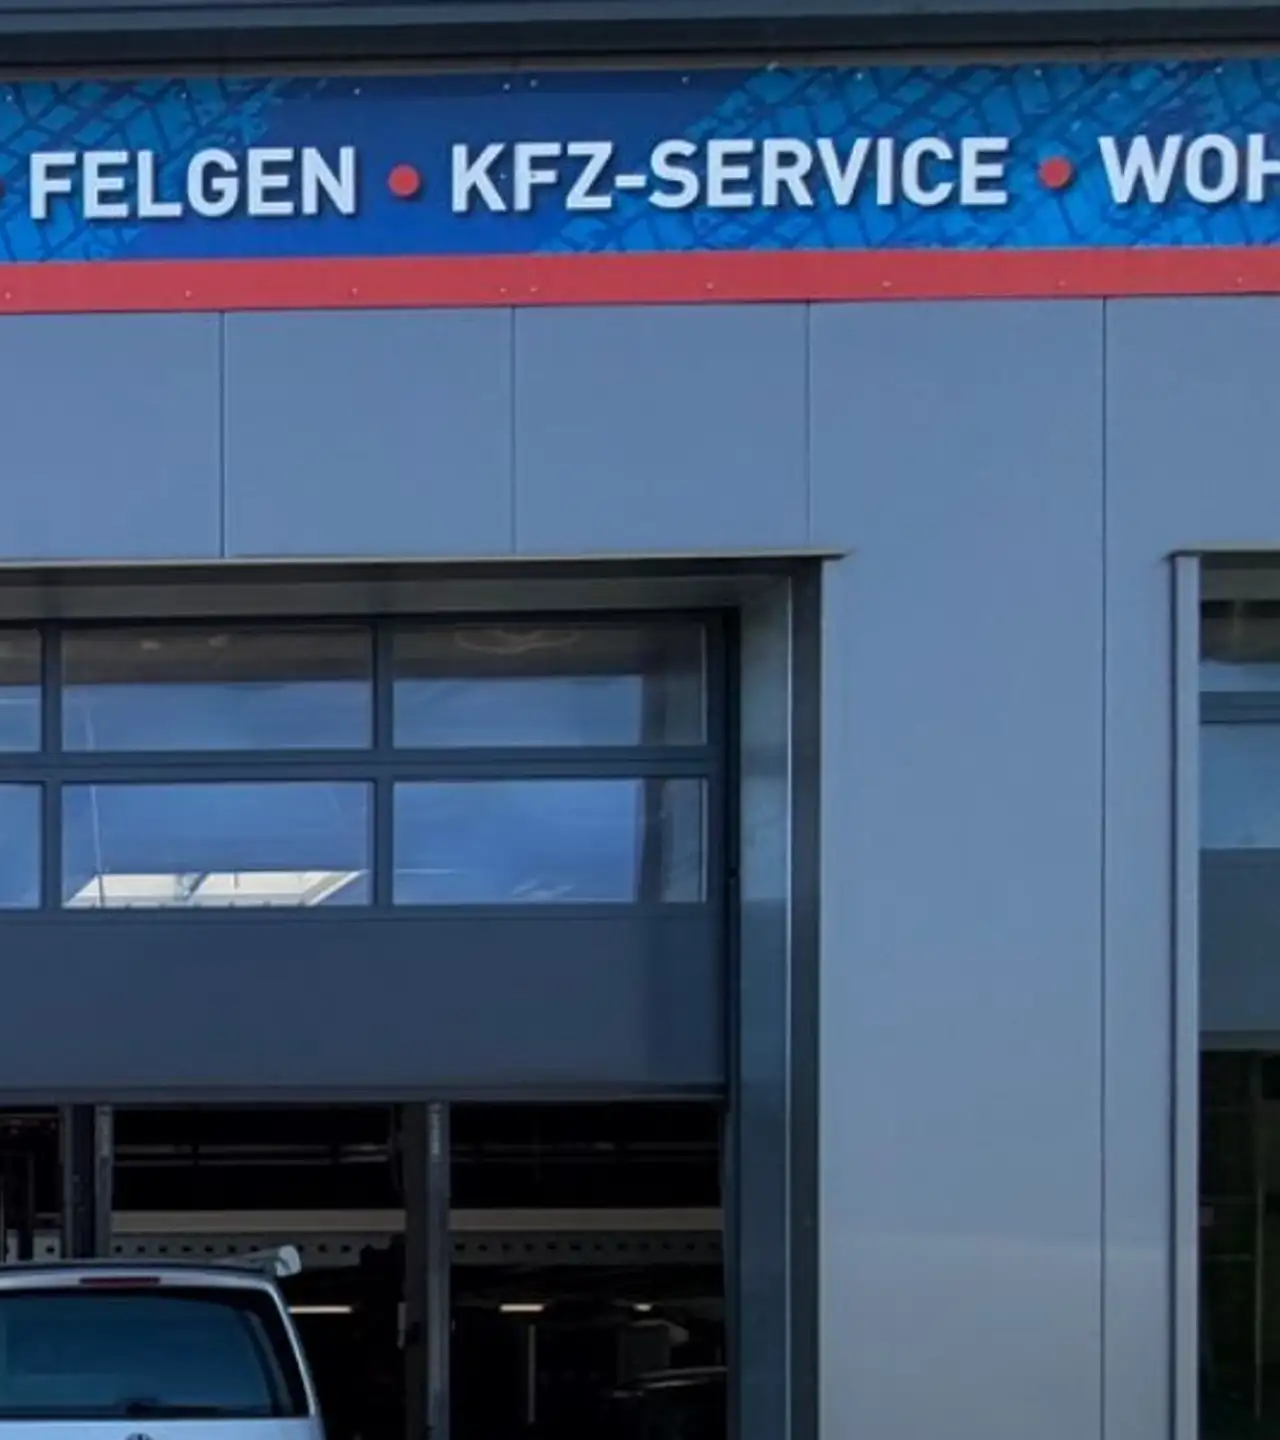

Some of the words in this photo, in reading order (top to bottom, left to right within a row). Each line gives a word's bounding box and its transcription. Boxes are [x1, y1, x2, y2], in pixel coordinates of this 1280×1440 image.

[30, 146, 356, 219] FELGEN
[451, 135, 1008, 213] KFZ-SERVICE
[1097, 133, 1280, 204] WOH
